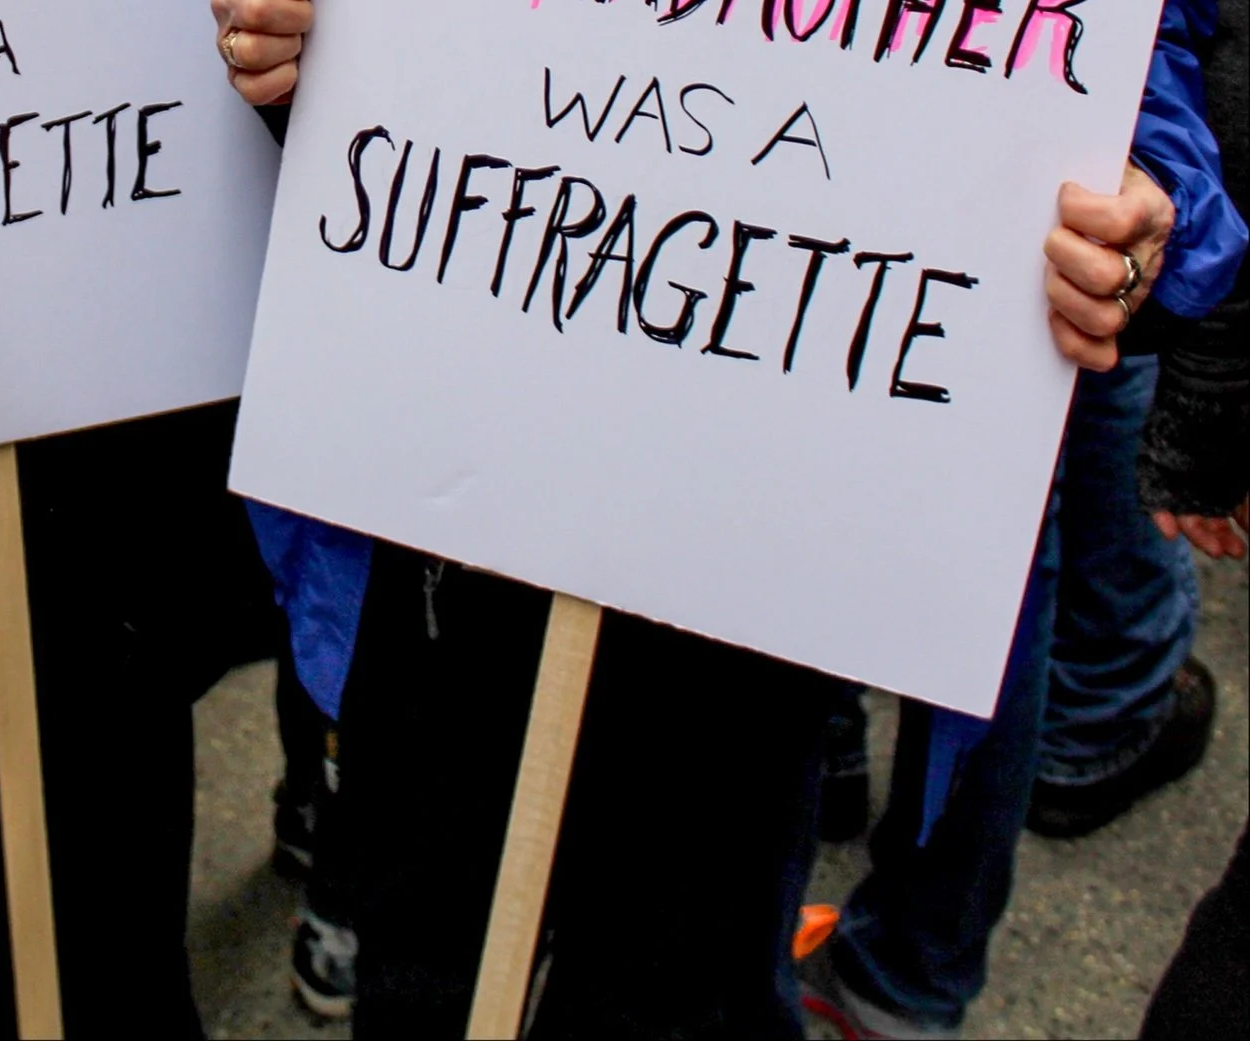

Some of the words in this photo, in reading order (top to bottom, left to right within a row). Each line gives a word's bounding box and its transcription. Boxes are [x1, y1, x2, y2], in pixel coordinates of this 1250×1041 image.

[545, 67, 735, 155] WAS
[751, 103, 830, 179] A
[319, 126, 979, 403] SUFFRAGETTE
